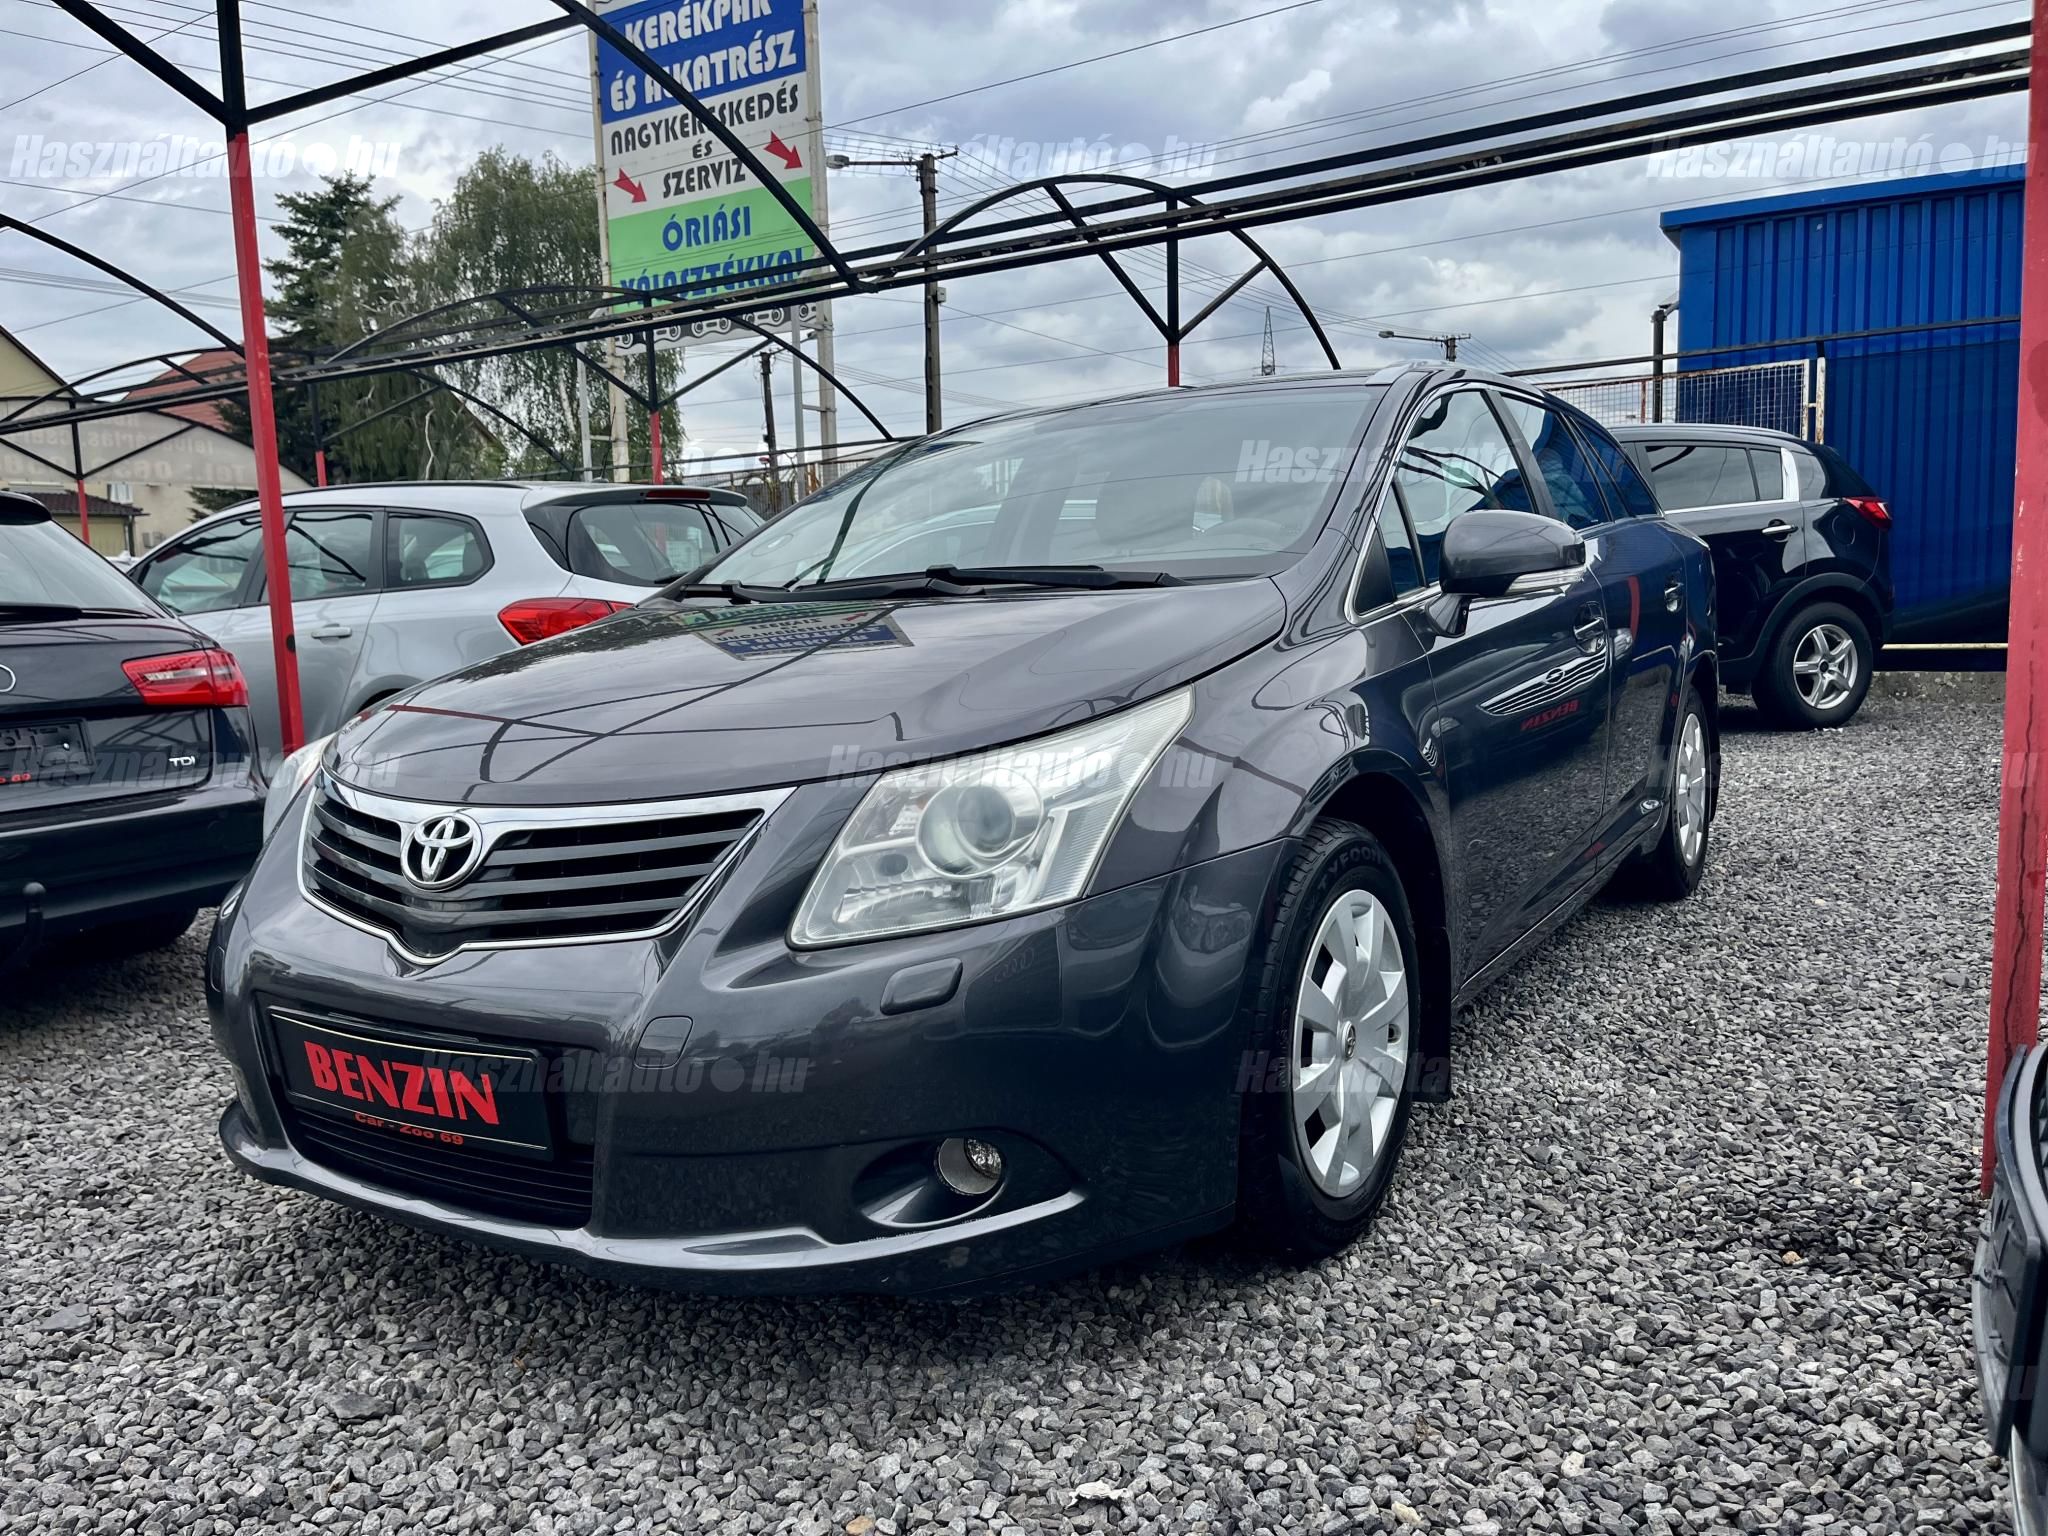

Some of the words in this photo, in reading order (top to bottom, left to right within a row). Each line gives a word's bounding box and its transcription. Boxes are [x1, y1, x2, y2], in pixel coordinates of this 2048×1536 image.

[609, 69, 637, 112] ÉS
[662, 157, 746, 199] SZERVIZ
[662, 203, 751, 252] ÓRIÁSI
[168, 755, 196, 768] TDI
[303, 1039, 500, 1126] BENZIN
[354, 1111, 385, 1129] Car
[399, 1120, 435, 1140] Zoo
[439, 1131, 465, 1146] 69
